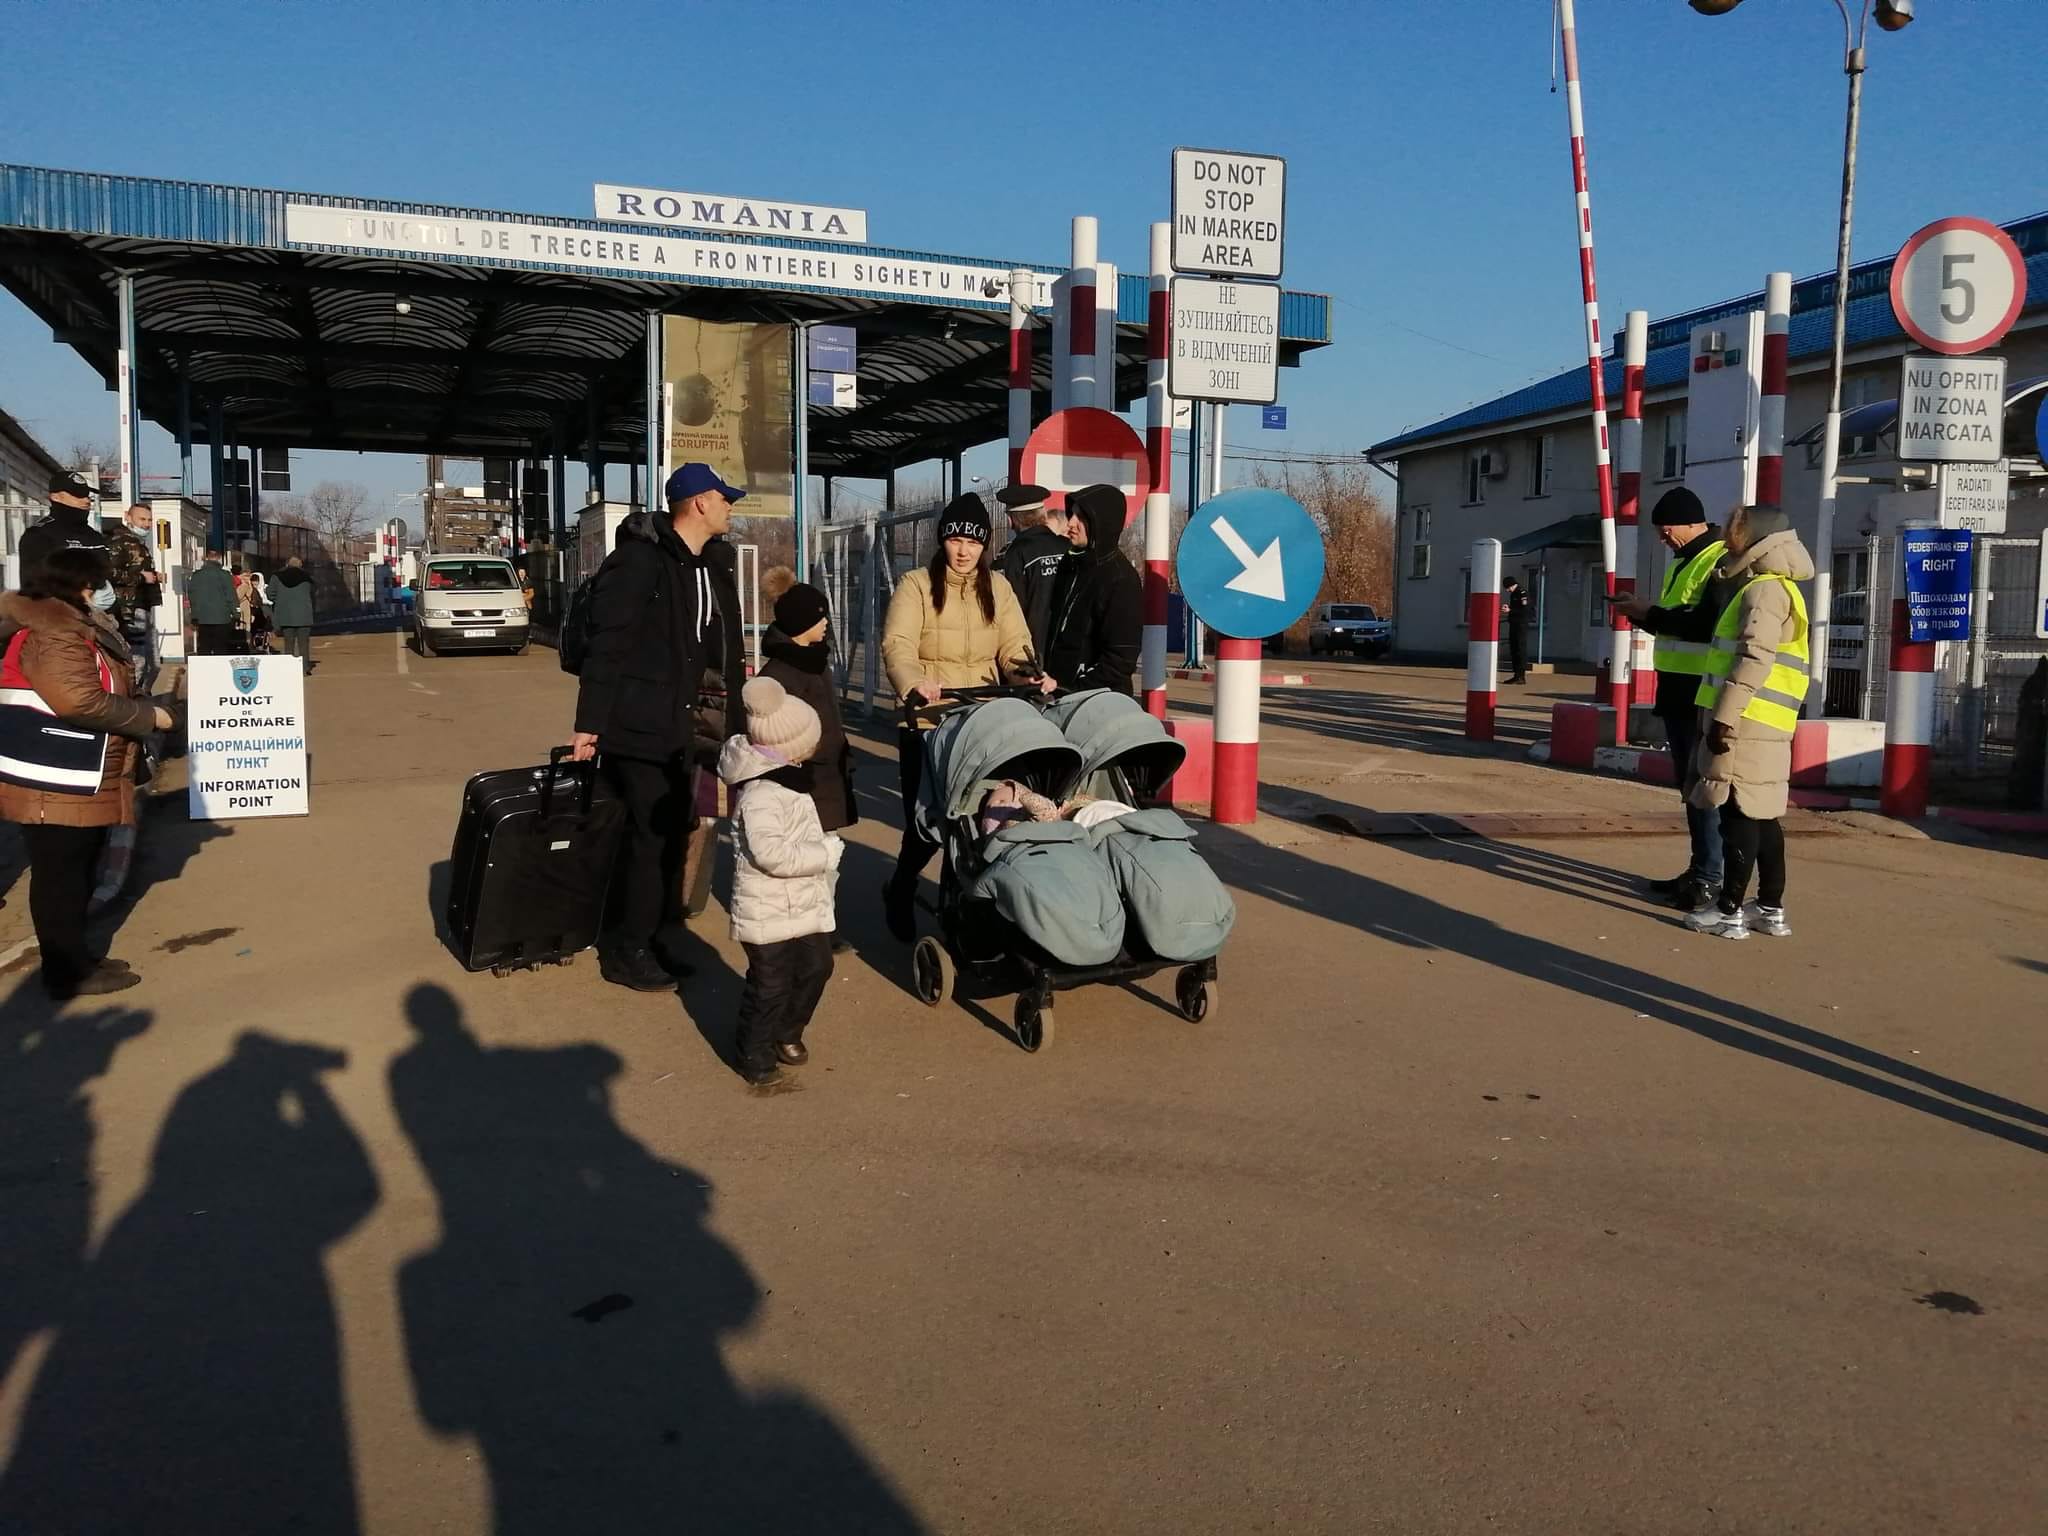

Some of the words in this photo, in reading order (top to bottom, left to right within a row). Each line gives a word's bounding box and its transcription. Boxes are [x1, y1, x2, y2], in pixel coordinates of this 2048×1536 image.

[1194, 161, 1221, 182] DO
[1228, 163, 1266, 186] NOT
[1205, 189, 1254, 212] STOP
[1180, 214, 1196, 235] IN
[1203, 216, 1277, 242] MARKED
[481, 229, 510, 250] DE
[530, 234, 640, 262] TRECERE
[654, 246, 666, 265] A
[695, 249, 836, 279] FRONTIEREI
[1202, 244, 1253, 267] AREA
[1219, 286, 1237, 305] НЕ
[1940, 253, 1976, 325] 5
[1177, 309, 1273, 335] ЗУПИНЯЙТЕСЬ
[1178, 338, 1186, 358] В
[1192, 340, 1272, 364] ВІДМІЧЕНІЙ
[1209, 369, 1240, 390] ЗОНІ
[1908, 369, 1932, 388] NU
[1940, 371, 1998, 391] OPRITI
[1914, 396, 1931, 413] IN
[1937, 396, 1987, 416] ZONA
[1905, 422, 1993, 442] MARCATA
[1957, 478, 1991, 492] RADIATII
[1987, 498, 1995, 512] SA
[1997, 499, 2005, 512] VA
[1953, 542, 1969, 551] KEEP
[1922, 560, 1956, 571] RIGHT
[219, 695, 273, 706] PUNCT
[200, 717, 296, 729] INFORMARE
[191, 736, 304, 753] ІНФОРМАЦІЙНИЙ
[226, 757, 270, 769] ПУНКТ
[200, 778, 301, 793] INFORMATION
[229, 796, 273, 808] POINT
